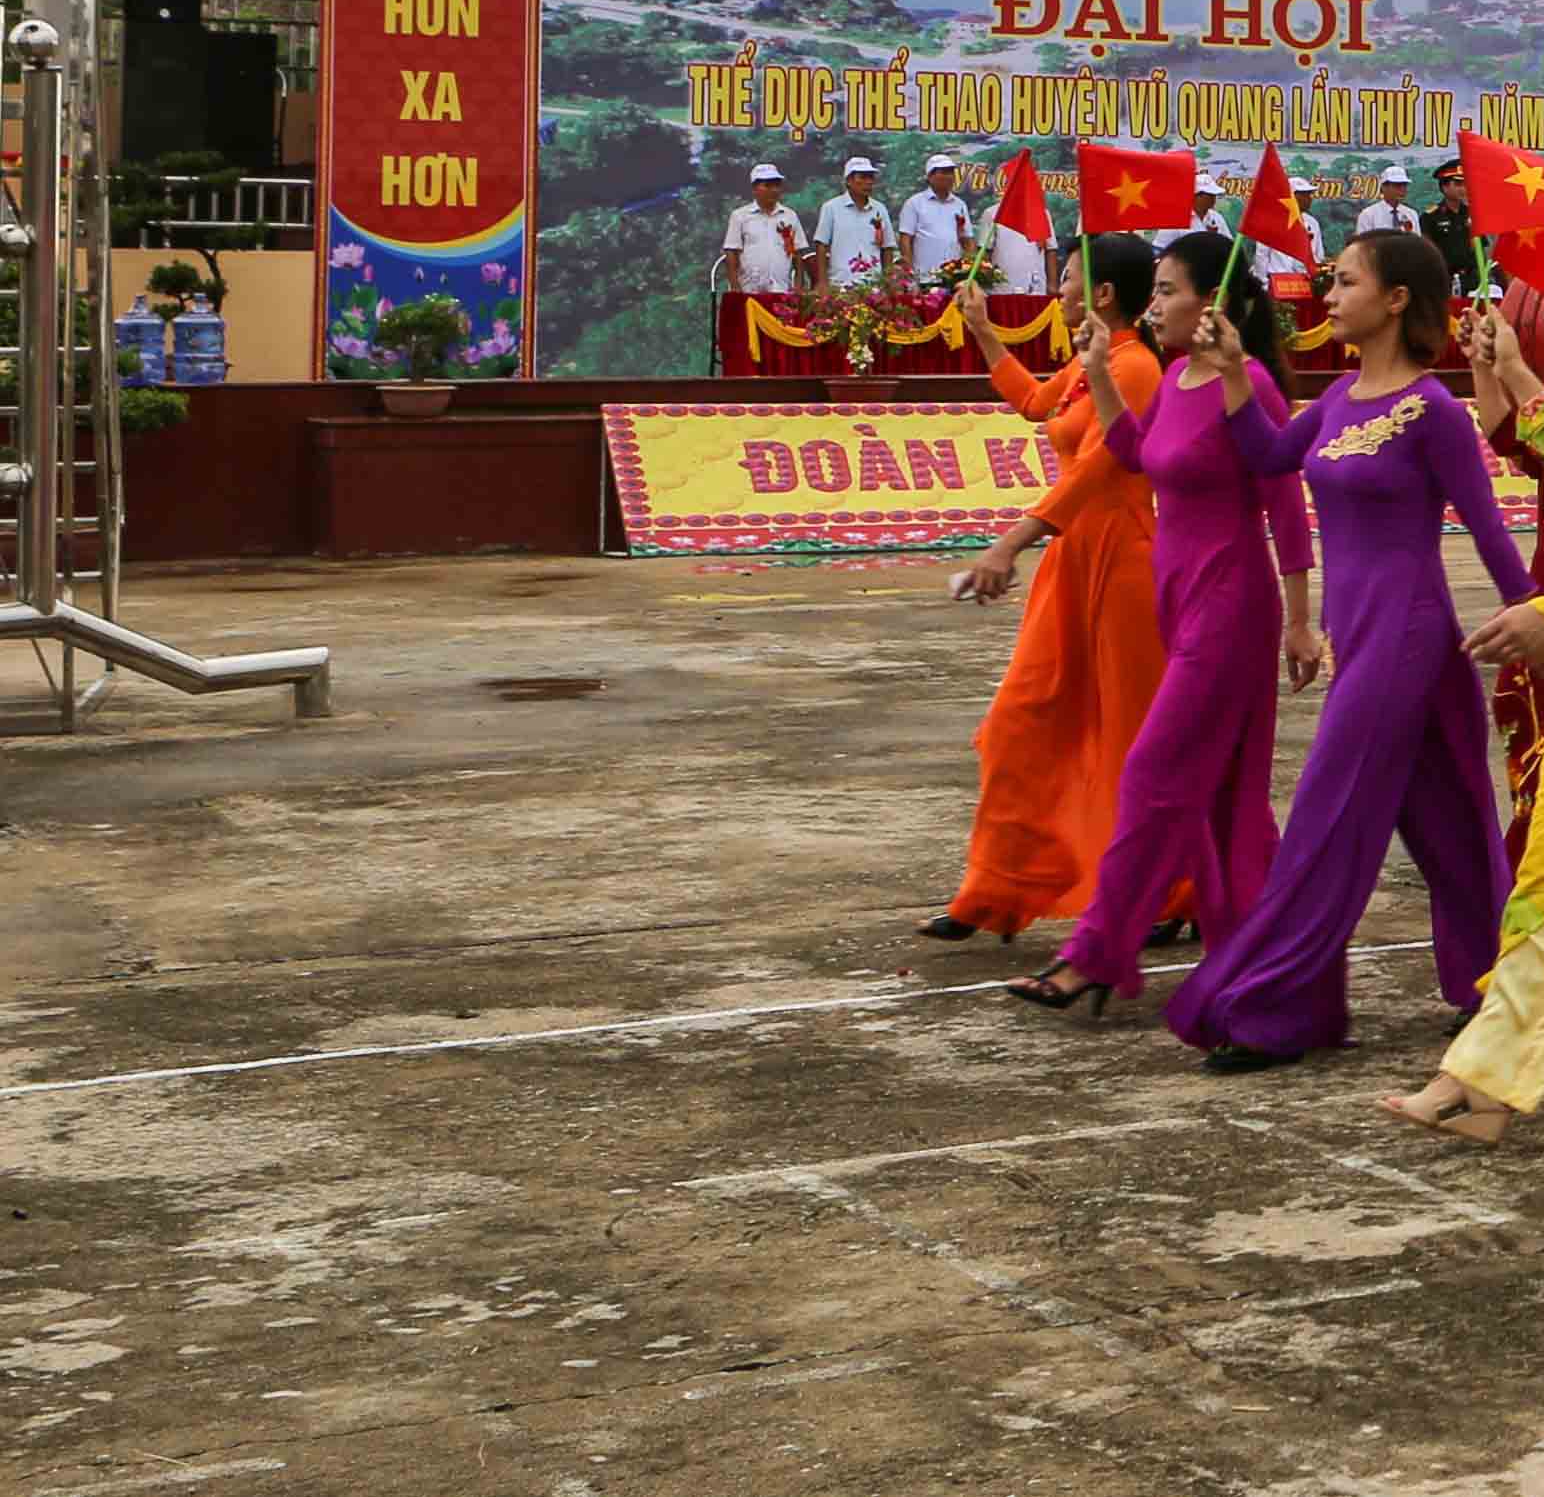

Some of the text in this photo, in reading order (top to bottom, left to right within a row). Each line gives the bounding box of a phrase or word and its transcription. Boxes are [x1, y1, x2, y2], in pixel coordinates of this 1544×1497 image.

[399, 69, 464, 122] XA
[687, 39, 756, 129] THỂ
[762, 65, 834, 143] DỤC
[844, 46, 911, 133] THỂ
[915, 71, 1003, 134] THAO
[1010, 65, 1119, 145] HUYỆN
[1126, 69, 1169, 140] VŨ
[1176, 81, 1285, 146] QUANG
[1291, 68, 1352, 145] LẦN
[1358, 74, 1422, 147] THỨ
[1423, 90, 1455, 148] IV
[380, 152, 478, 208] HƠN
[737, 422, 966, 494] ĐOÀN
